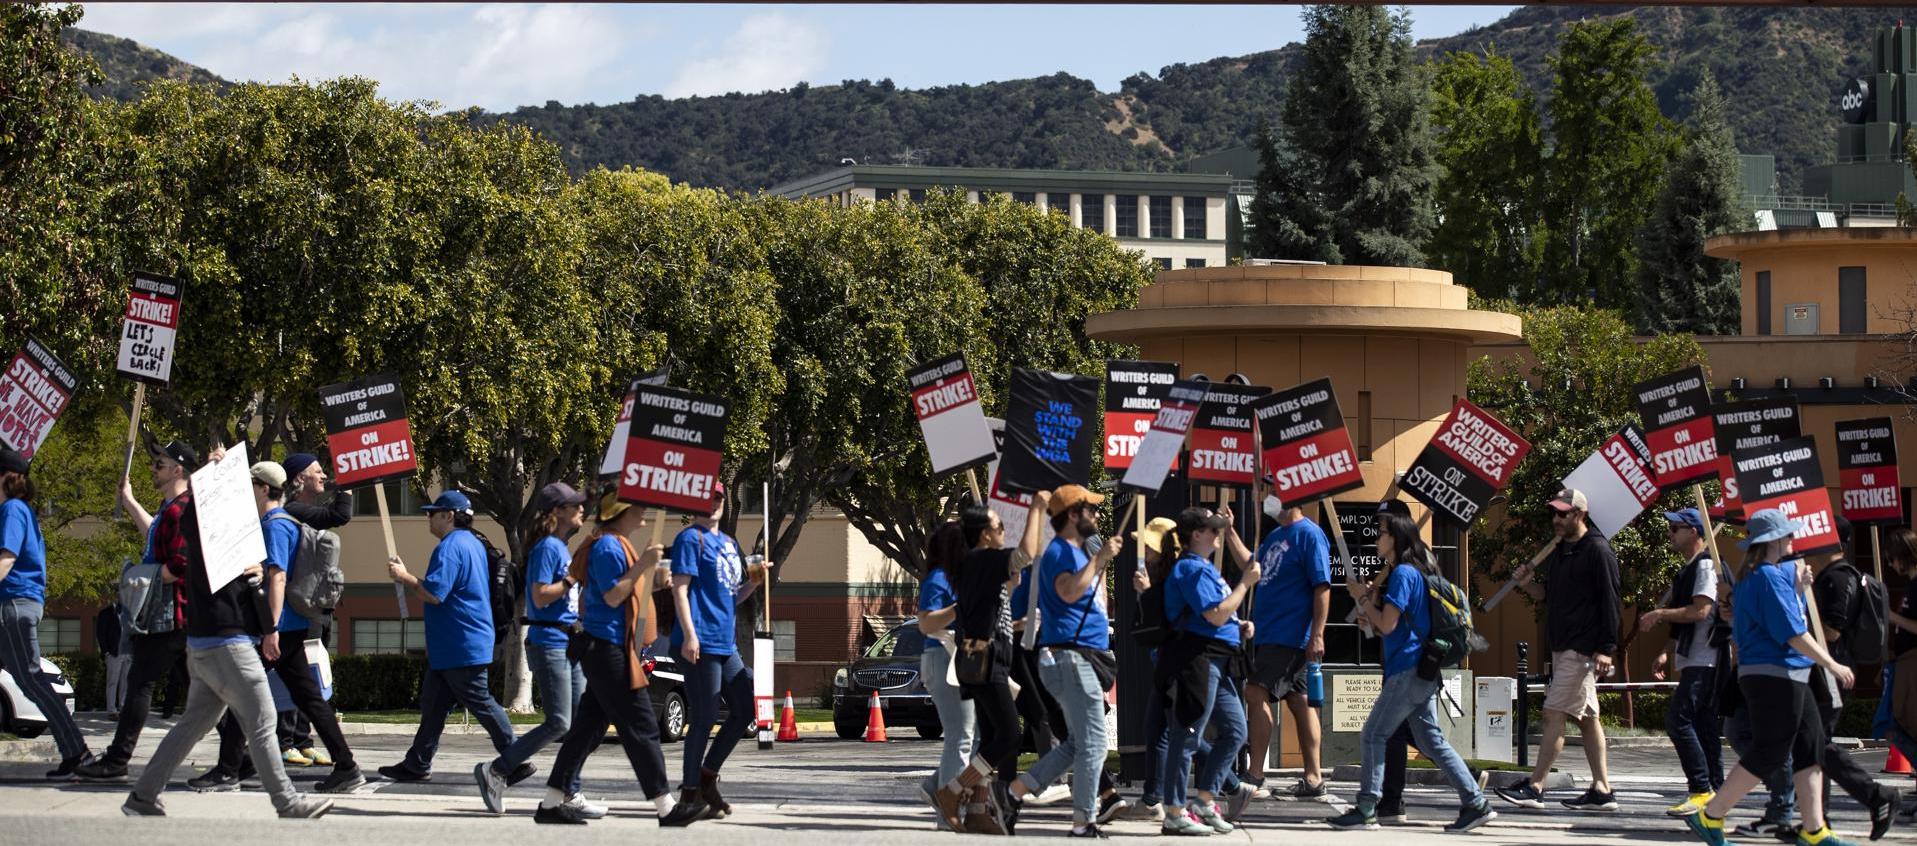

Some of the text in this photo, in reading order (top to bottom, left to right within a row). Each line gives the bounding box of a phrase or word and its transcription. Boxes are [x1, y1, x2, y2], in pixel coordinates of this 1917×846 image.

[1842, 89, 1863, 110] abc
[129, 298, 173, 324] STRIKE!
[131, 343, 165, 361] CIRCLE
[26, 340, 76, 389] WRITERS GUILD
[130, 357, 160, 376] BACK!
[911, 359, 964, 387] WRITERS GUILD
[10, 358, 65, 414] STRIKE!
[1110, 371, 1175, 385] WRITERS GUILD
[325, 383, 395, 406] WRITERS GUILD
[916, 378, 973, 416] STRIKE!
[1137, 386, 1148, 396] OF
[1638, 377, 1700, 404] WRITERS GUILD
[357, 401, 367, 411] OF
[640, 391, 690, 412] WRITERS
[691, 401, 725, 417] GUILD
[1049, 400, 1073, 415] WE
[1122, 397, 1161, 409] AMERICA
[1226, 406, 1237, 415] OF
[1257, 398, 1300, 420] WRITERS
[1300, 390, 1329, 407] GUILD
[1668, 398, 1678, 408] OF
[13, 394, 51, 443] HAVE
[344, 409, 387, 427] AMERICA
[673, 414, 687, 424] OF
[1034, 411, 1083, 428] STAND
[1153, 406, 1194, 431] STRIKE!
[1210, 415, 1251, 429] AMERICA
[1291, 412, 1302, 423] OF
[1658, 405, 1695, 425] AMERICA
[1716, 407, 1793, 425] WRITERS GUILD
[651, 424, 702, 443] AMERICA
[1037, 424, 1077, 440] WITH
[1134, 419, 1151, 433] ON
[1279, 419, 1324, 441] AMERICA
[1456, 407, 1519, 457] WRITERS
[1750, 424, 1762, 434] OF
[1838, 427, 1890, 442] WRITERS GUILD
[361, 431, 378, 446] ON
[1221, 436, 1238, 449] ON
[1450, 421, 1509, 466] GUILD OF
[1674, 429, 1691, 444] ON
[1736, 434, 1780, 449] AMERICA
[1861, 441, 1869, 450] OF
[336, 439, 410, 474] STRIKE!
[663, 451, 685, 467] ON
[1299, 443, 1318, 459] ON
[1438, 431, 1502, 482] AMERICA
[1654, 437, 1718, 475] STRIKE!
[1737, 447, 1812, 473] WRITERS GUILD
[1851, 453, 1882, 465] AMERICA
[1192, 449, 1254, 473] STRIKE
[1276, 449, 1354, 491] STRIKE!
[624, 462, 713, 500] STRIKE!
[1444, 466, 1467, 487] ON
[1604, 441, 1657, 502] STRIKE!
[1772, 468, 1784, 479] OF
[1862, 473, 1875, 485] ON
[1406, 465, 1479, 524] STRIKE
[1760, 476, 1805, 496] AMERICA
[1778, 500, 1798, 515] ON
[1843, 486, 1898, 510] STRIKE!
